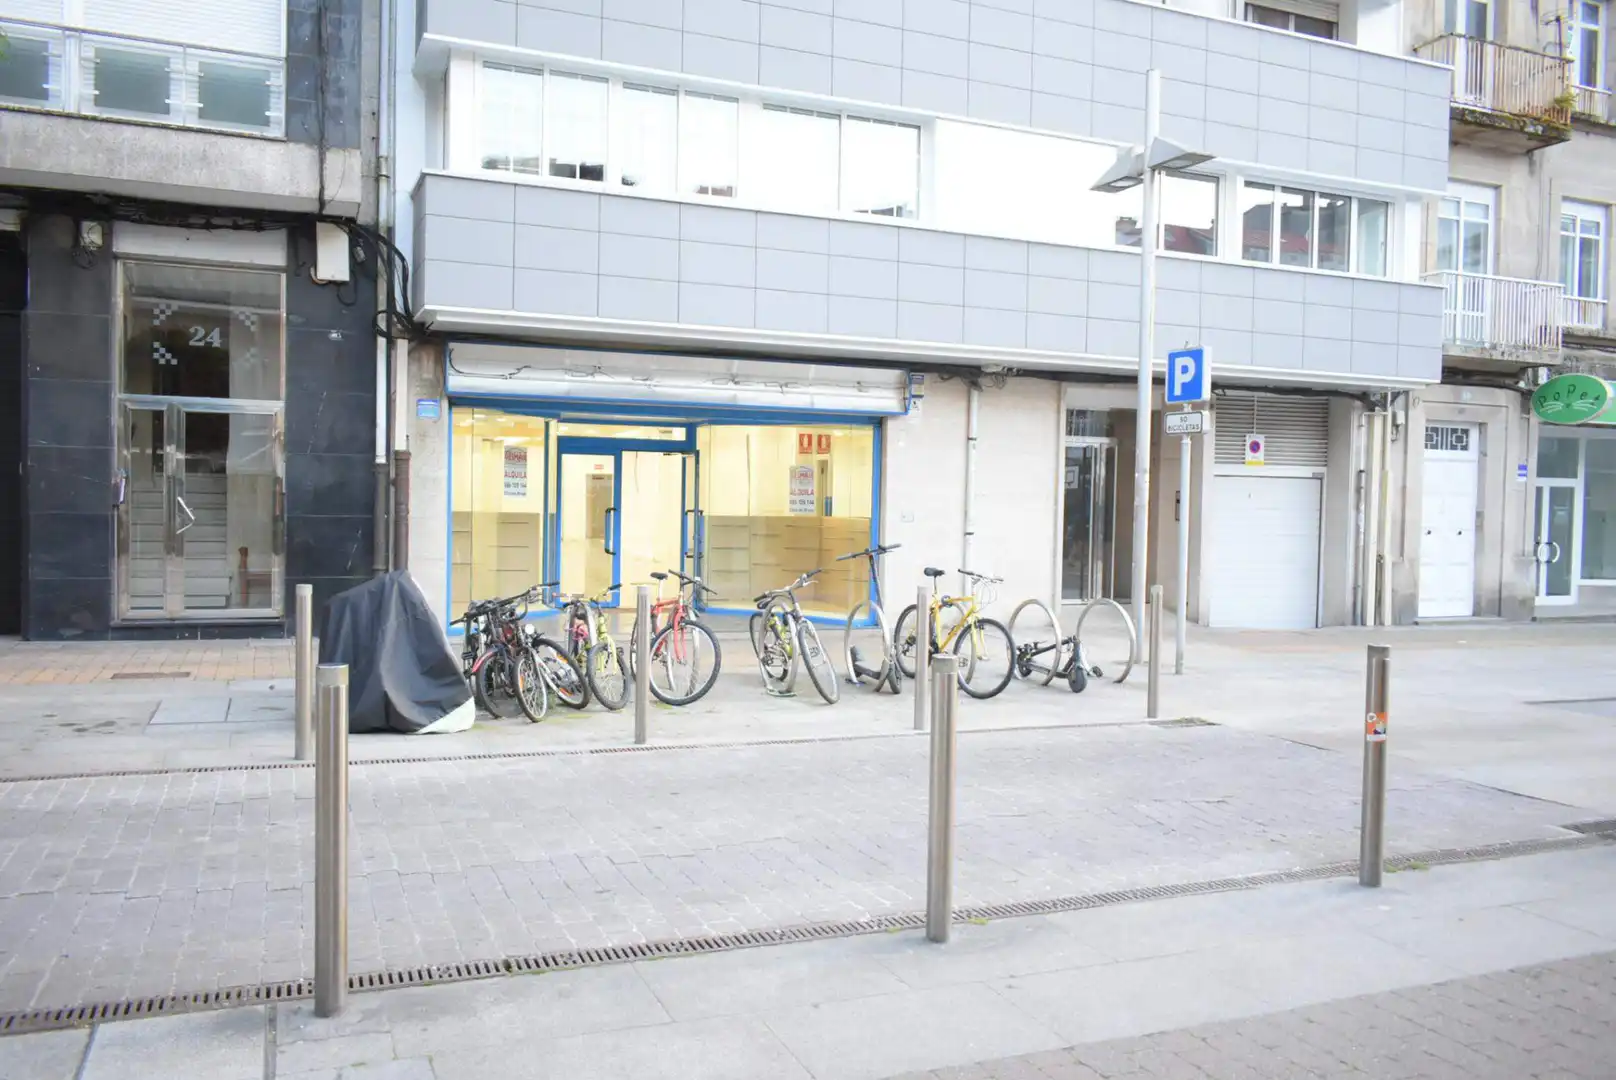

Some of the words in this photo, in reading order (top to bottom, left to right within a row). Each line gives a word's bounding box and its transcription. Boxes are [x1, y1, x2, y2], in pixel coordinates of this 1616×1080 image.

[189, 326, 222, 348] 24
[1174, 356, 1196, 396] P
[1168, 424, 1200, 432] BICICLETAS
